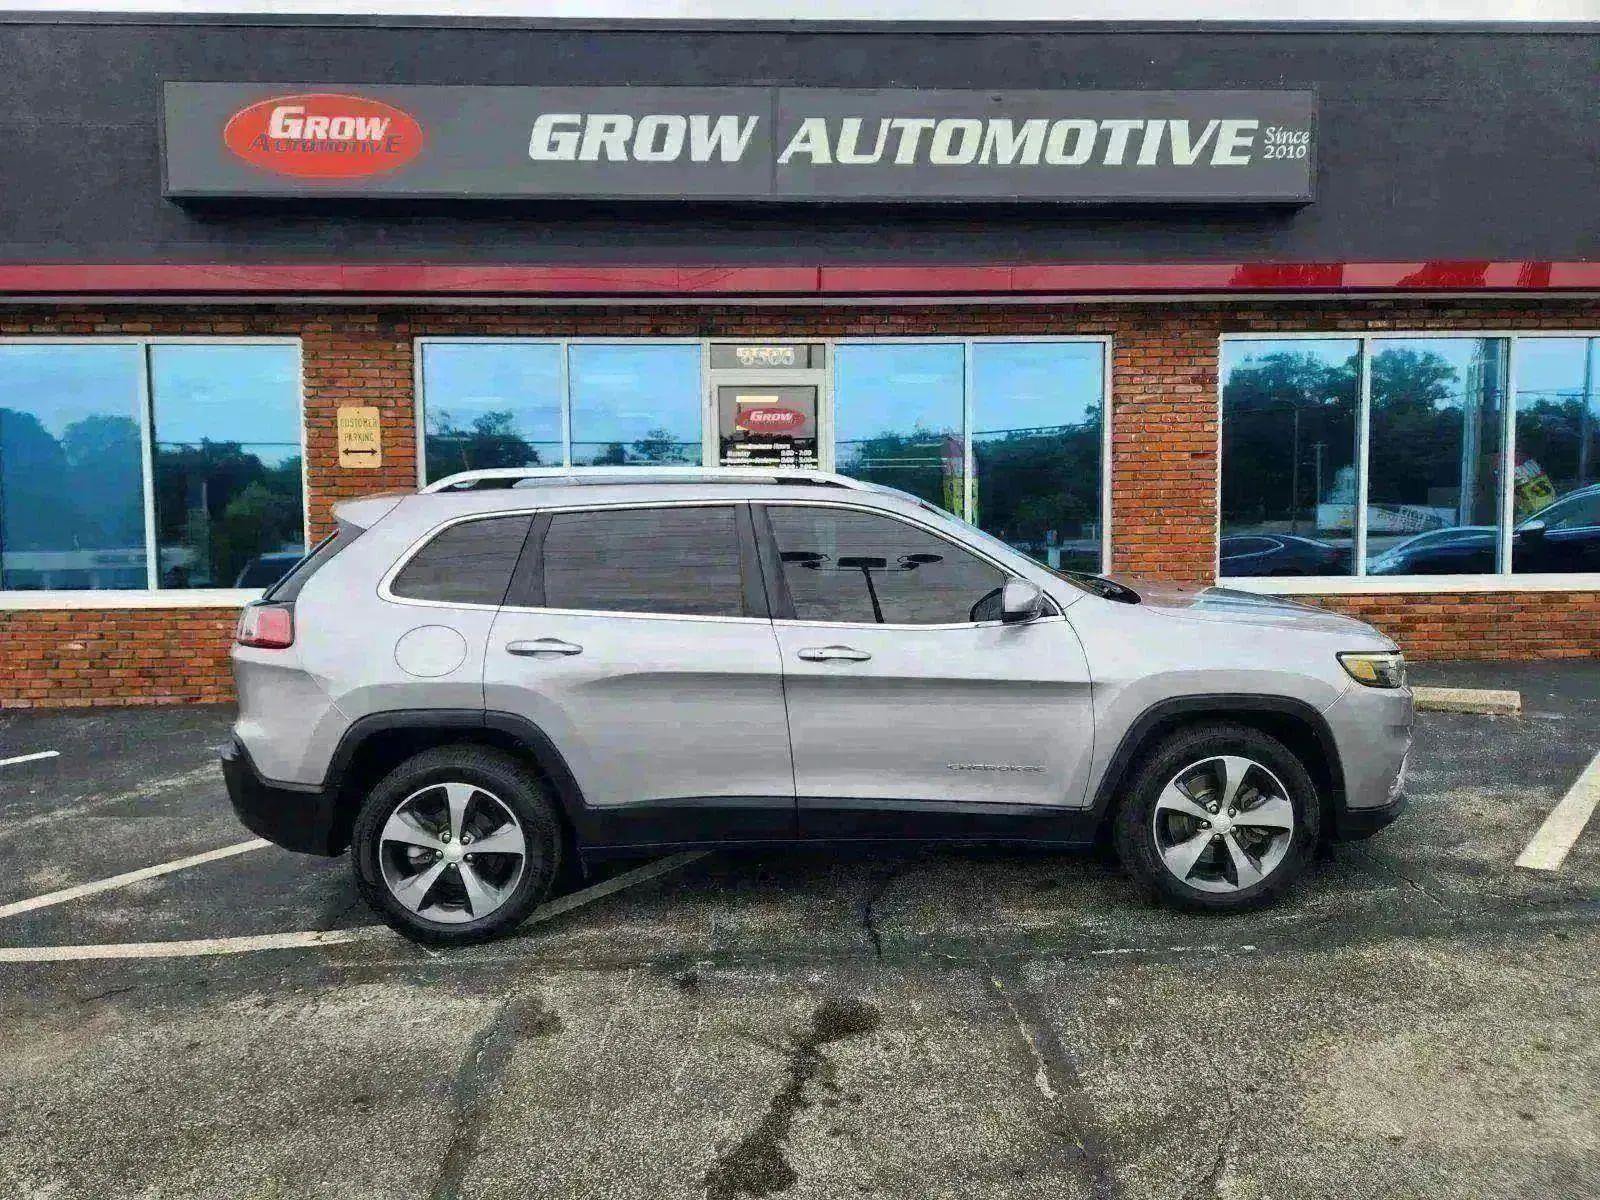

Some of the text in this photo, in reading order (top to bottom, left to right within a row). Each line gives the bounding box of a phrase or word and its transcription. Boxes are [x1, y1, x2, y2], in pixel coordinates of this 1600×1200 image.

[269, 106, 390, 140] GROW
[248, 133, 401, 153] AUTOMOTIVE
[529, 113, 1259, 165] GROW AUTOMOTIVE
[1264, 126, 1310, 145] Since
[1263, 145, 1307, 159] 2010
[340, 418, 378, 428] CUSTOMER
[750, 410, 793, 422] GROW
[344, 432, 374, 442] PARKING
